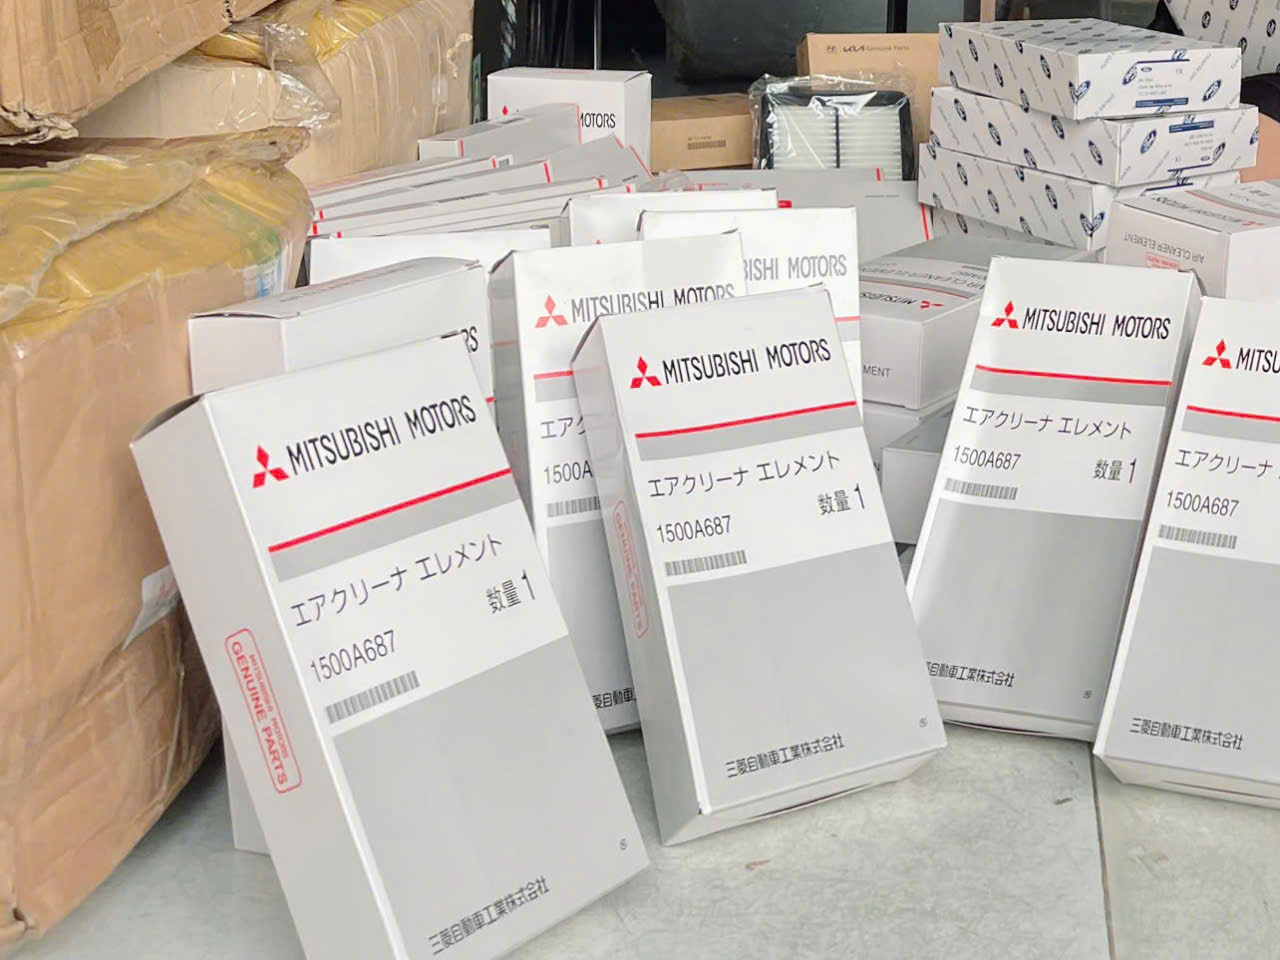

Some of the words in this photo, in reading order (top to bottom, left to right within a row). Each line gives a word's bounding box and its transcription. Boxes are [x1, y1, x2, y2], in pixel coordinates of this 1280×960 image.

[788, 254, 847, 279] MOTORS
[1022, 307, 1106, 336] MITSUBISHI
[1112, 314, 1171, 339] MOTORS
[662, 348, 759, 384] MITSUBISHI
[767, 338, 832, 370] MOTORS
[287, 415, 402, 475] MITSUBISHI
[405, 395, 477, 439] MOTORS
[963, 406, 1053, 433] エアクリーナ
[1058, 417, 1132, 440] エレメント
[648, 468, 749, 498] エアクリーナ
[756, 450, 840, 483] エレメント
[954, 445, 1021, 471] 1500A687
[1093, 459, 1122, 481] 数量
[1175, 449, 1273, 478] エアクリーナ
[817, 489, 851, 515] 数量
[1167, 490, 1239, 517] 1500A687
[656, 515, 732, 543] 1500A687
[291, 569, 408, 627] エアクリーナ
[416, 535, 502, 581] エレメント
[486, 579, 522, 614] 数量
[310, 629, 398, 682] 1500A687
[231, 641, 267, 721] GENUINE
[262, 726, 288, 785] PARTS
[1129, 717, 1243, 750] 三菱自動車工業株式会社
[725, 733, 844, 779] 三菱自動車工業株式会社
[428, 876, 550, 956] 三菱自動車工業株式会社
